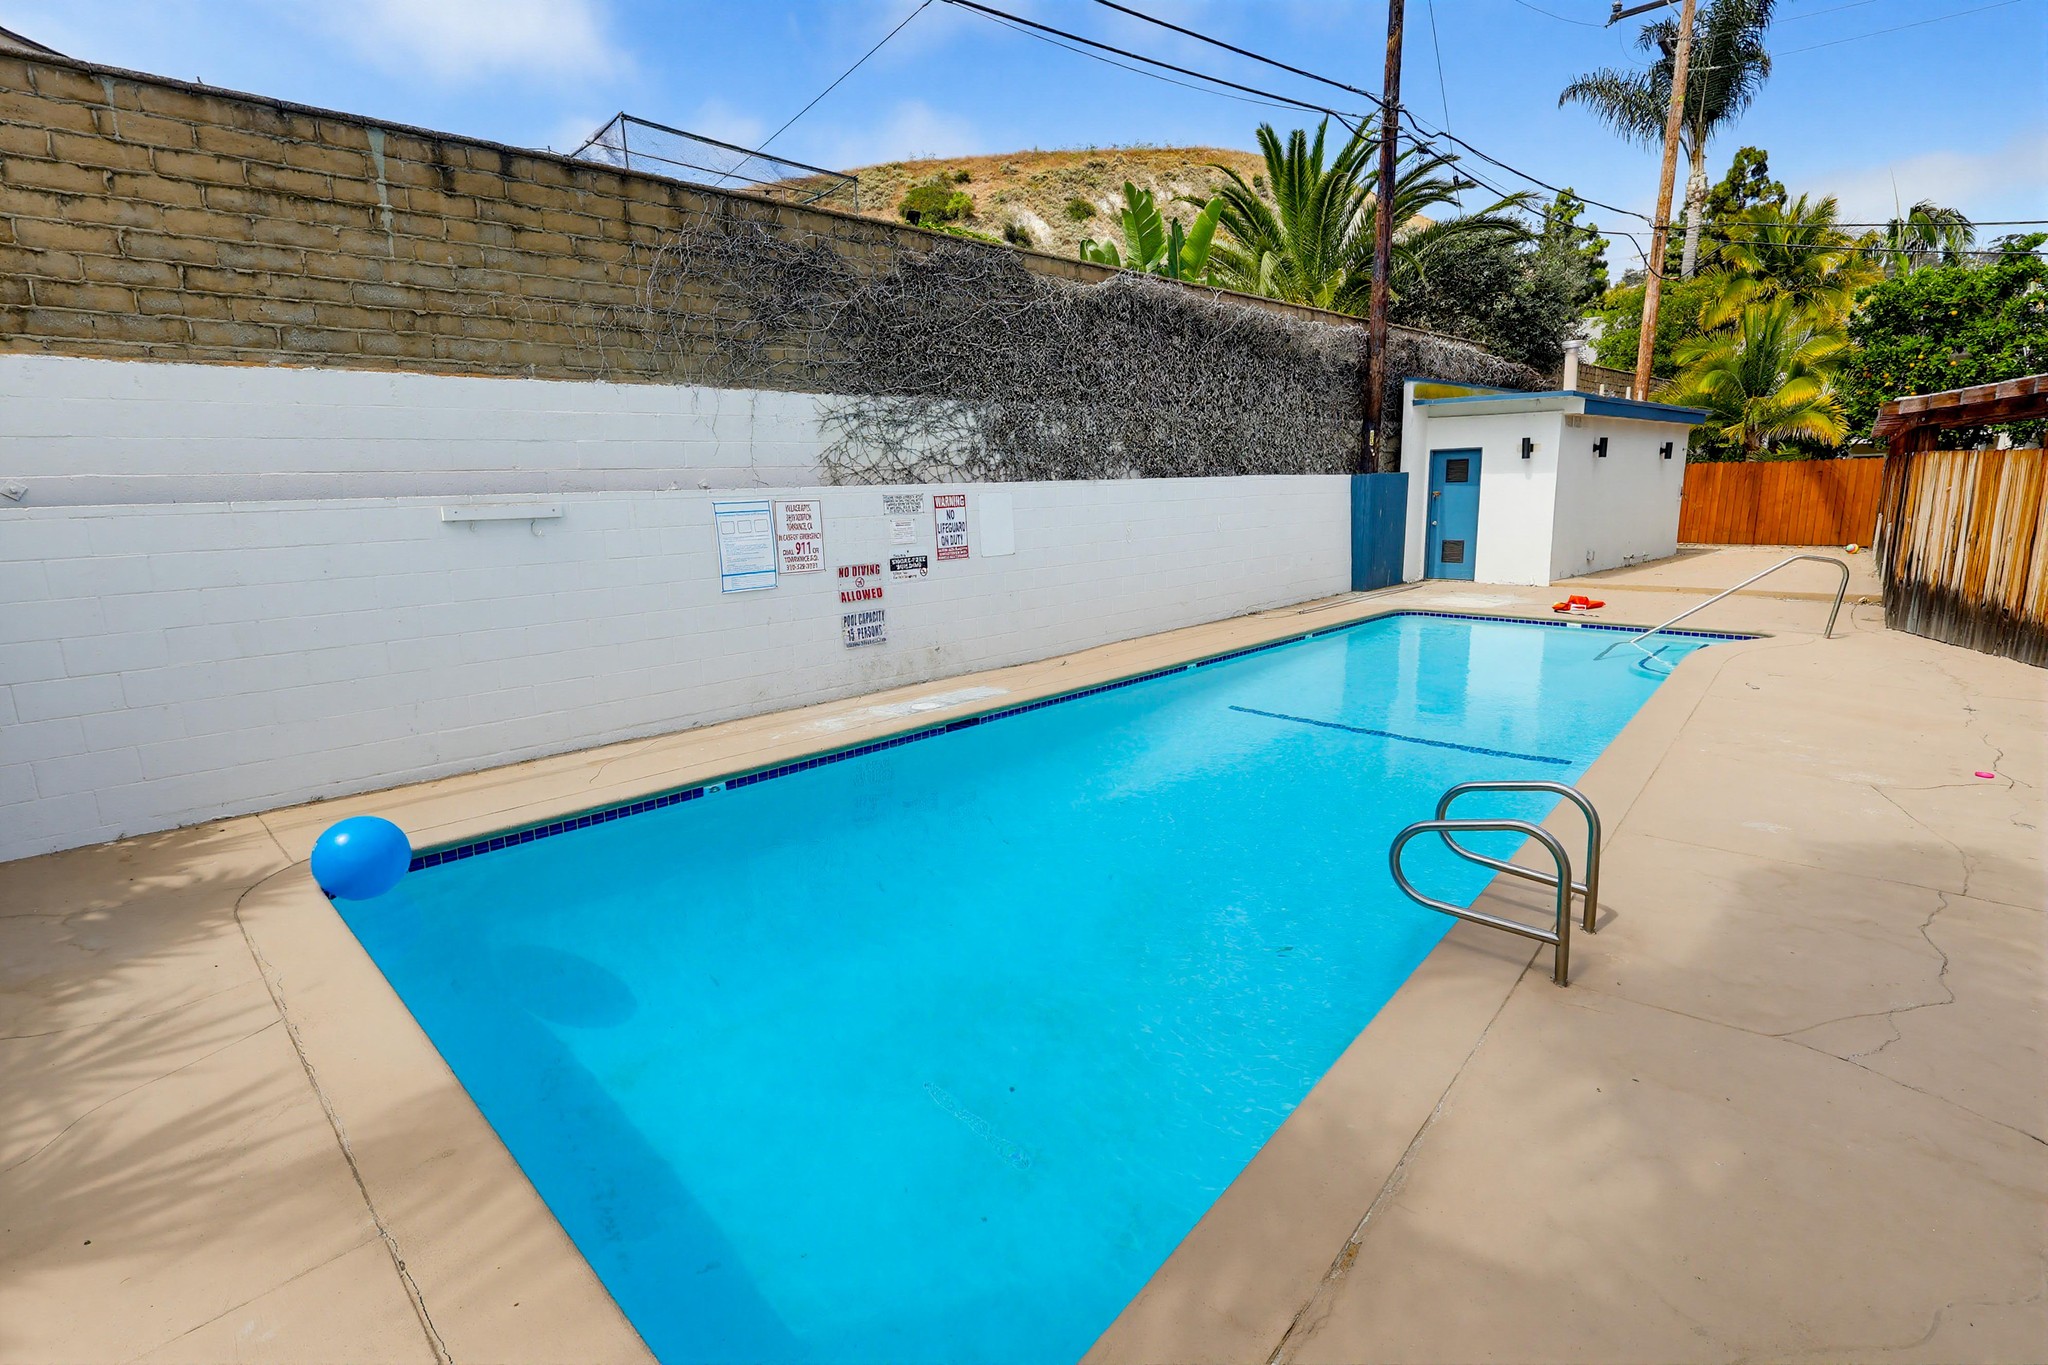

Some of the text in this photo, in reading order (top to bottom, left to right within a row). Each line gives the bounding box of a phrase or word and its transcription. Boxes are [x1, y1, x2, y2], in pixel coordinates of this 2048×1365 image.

[935, 496, 965, 507] WARNING
[946, 509, 955, 520] NO
[937, 521, 965, 534] LIFEGUARD
[941, 534, 963, 546] ON DUTY
[795, 541, 811, 555] 911
[838, 564, 880, 578] NO DIVING
[841, 587, 883, 603] ALLOWED
[844, 610, 885, 627] POOL CAPACITY
[847, 624, 882, 641] 15 PERSONS
